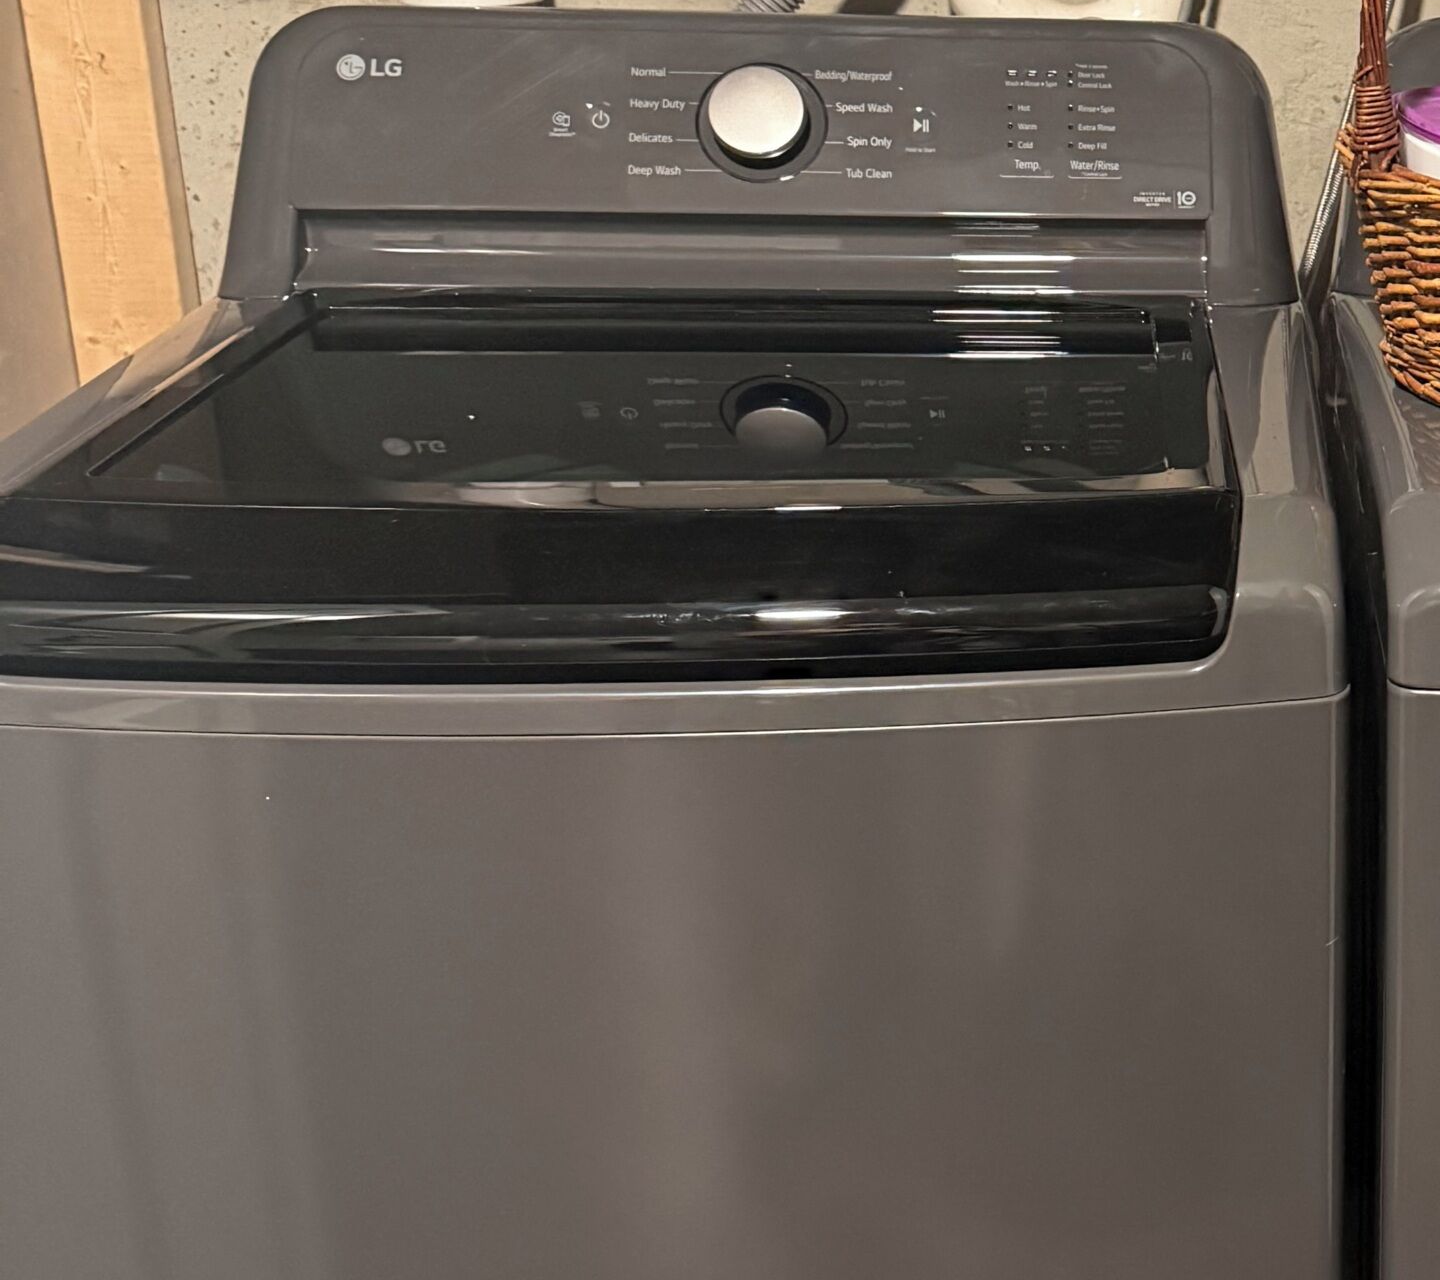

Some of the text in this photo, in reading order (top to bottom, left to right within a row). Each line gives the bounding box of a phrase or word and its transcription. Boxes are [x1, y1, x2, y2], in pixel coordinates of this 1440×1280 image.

[370, 58, 403, 77] LG
[631, 67, 667, 77] Normal
[815, 70, 893, 83] Bedding/Waterproof
[629, 98, 685, 112] Heavy Duty
[835, 102, 893, 114] Speed Wash
[628, 132, 673, 143] Delicates
[847, 136, 893, 150] Spin Only
[628, 164, 682, 178] Deep Wash
[1014, 159, 1041, 172] Temp.
[1070, 160, 1120, 172] Water/Rinse
[846, 168, 893, 179] Tub Clean
